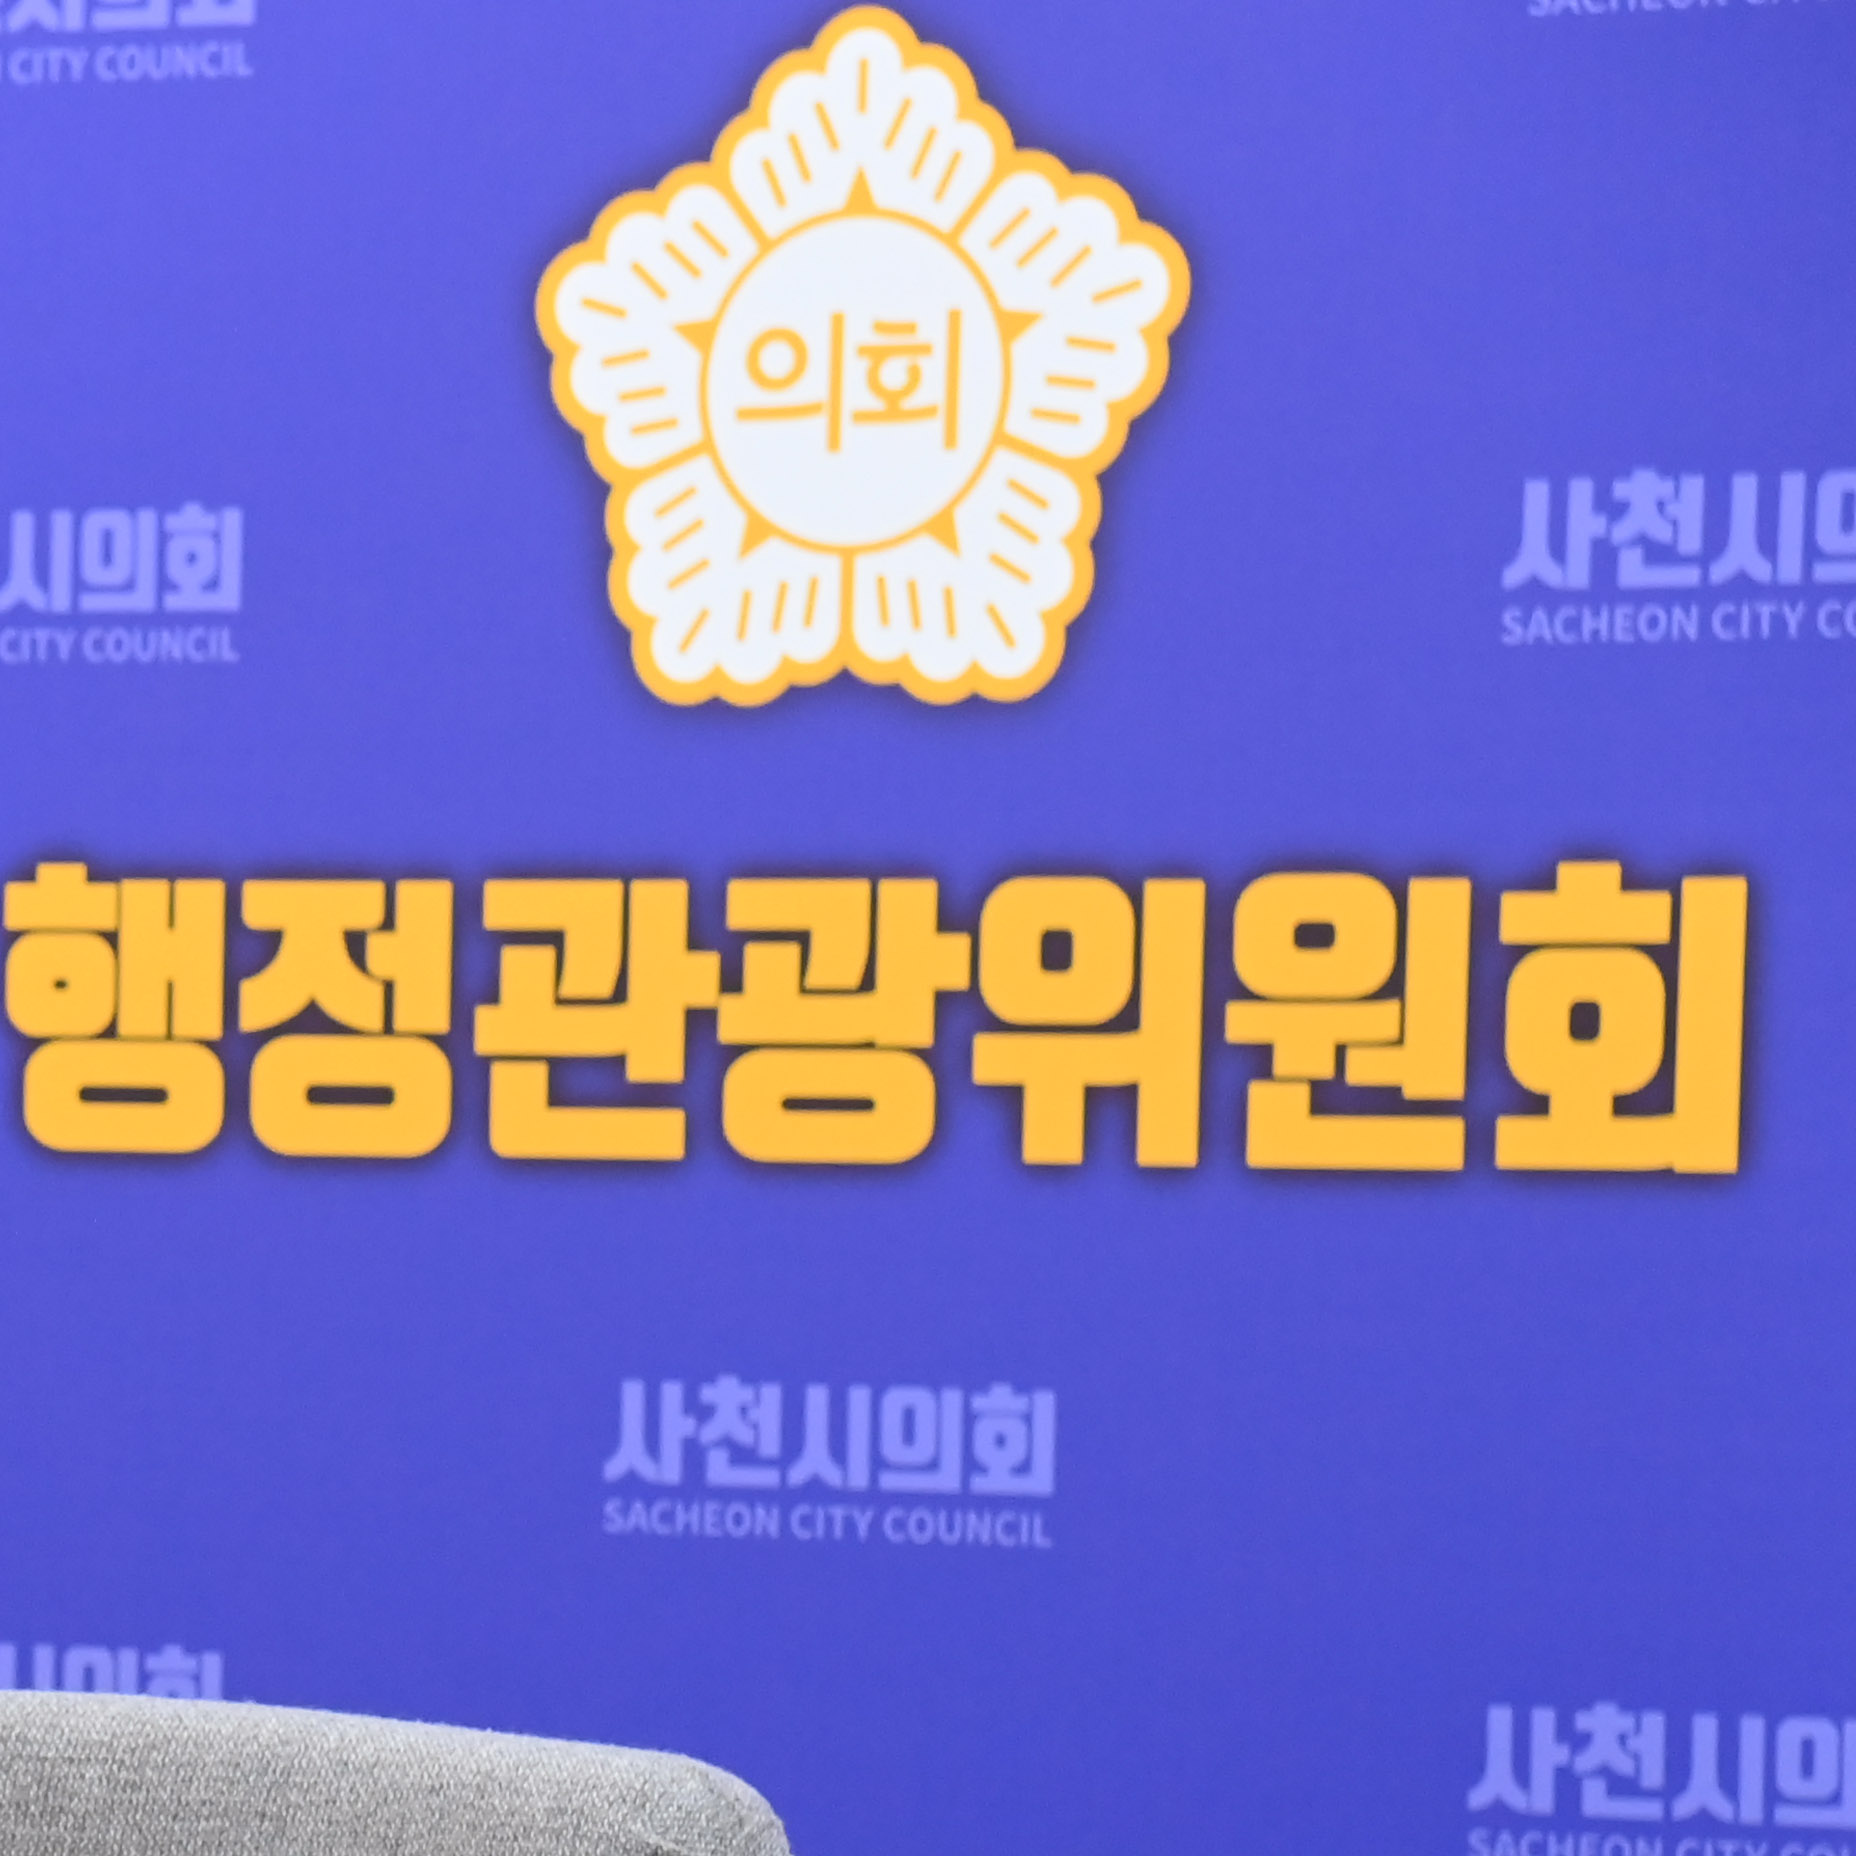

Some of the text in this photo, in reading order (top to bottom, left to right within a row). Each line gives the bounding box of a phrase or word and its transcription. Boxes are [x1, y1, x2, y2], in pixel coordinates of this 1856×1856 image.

[8, 46, 89, 86] CITY
[94, 40, 254, 82] COUNCIL
[737, 309, 962, 452] 의회
[82, 626, 240, 664] COUNCIL
[1502, 603, 1699, 645] SACHEON
[1711, 601, 1800, 641] CITY
[6, 862, 1747, 1173] 행정관광위원회
[603, 1375, 1056, 1496] 사천시의회
[603, 1498, 1052, 1548] SACHEON CITY COUNCIL
